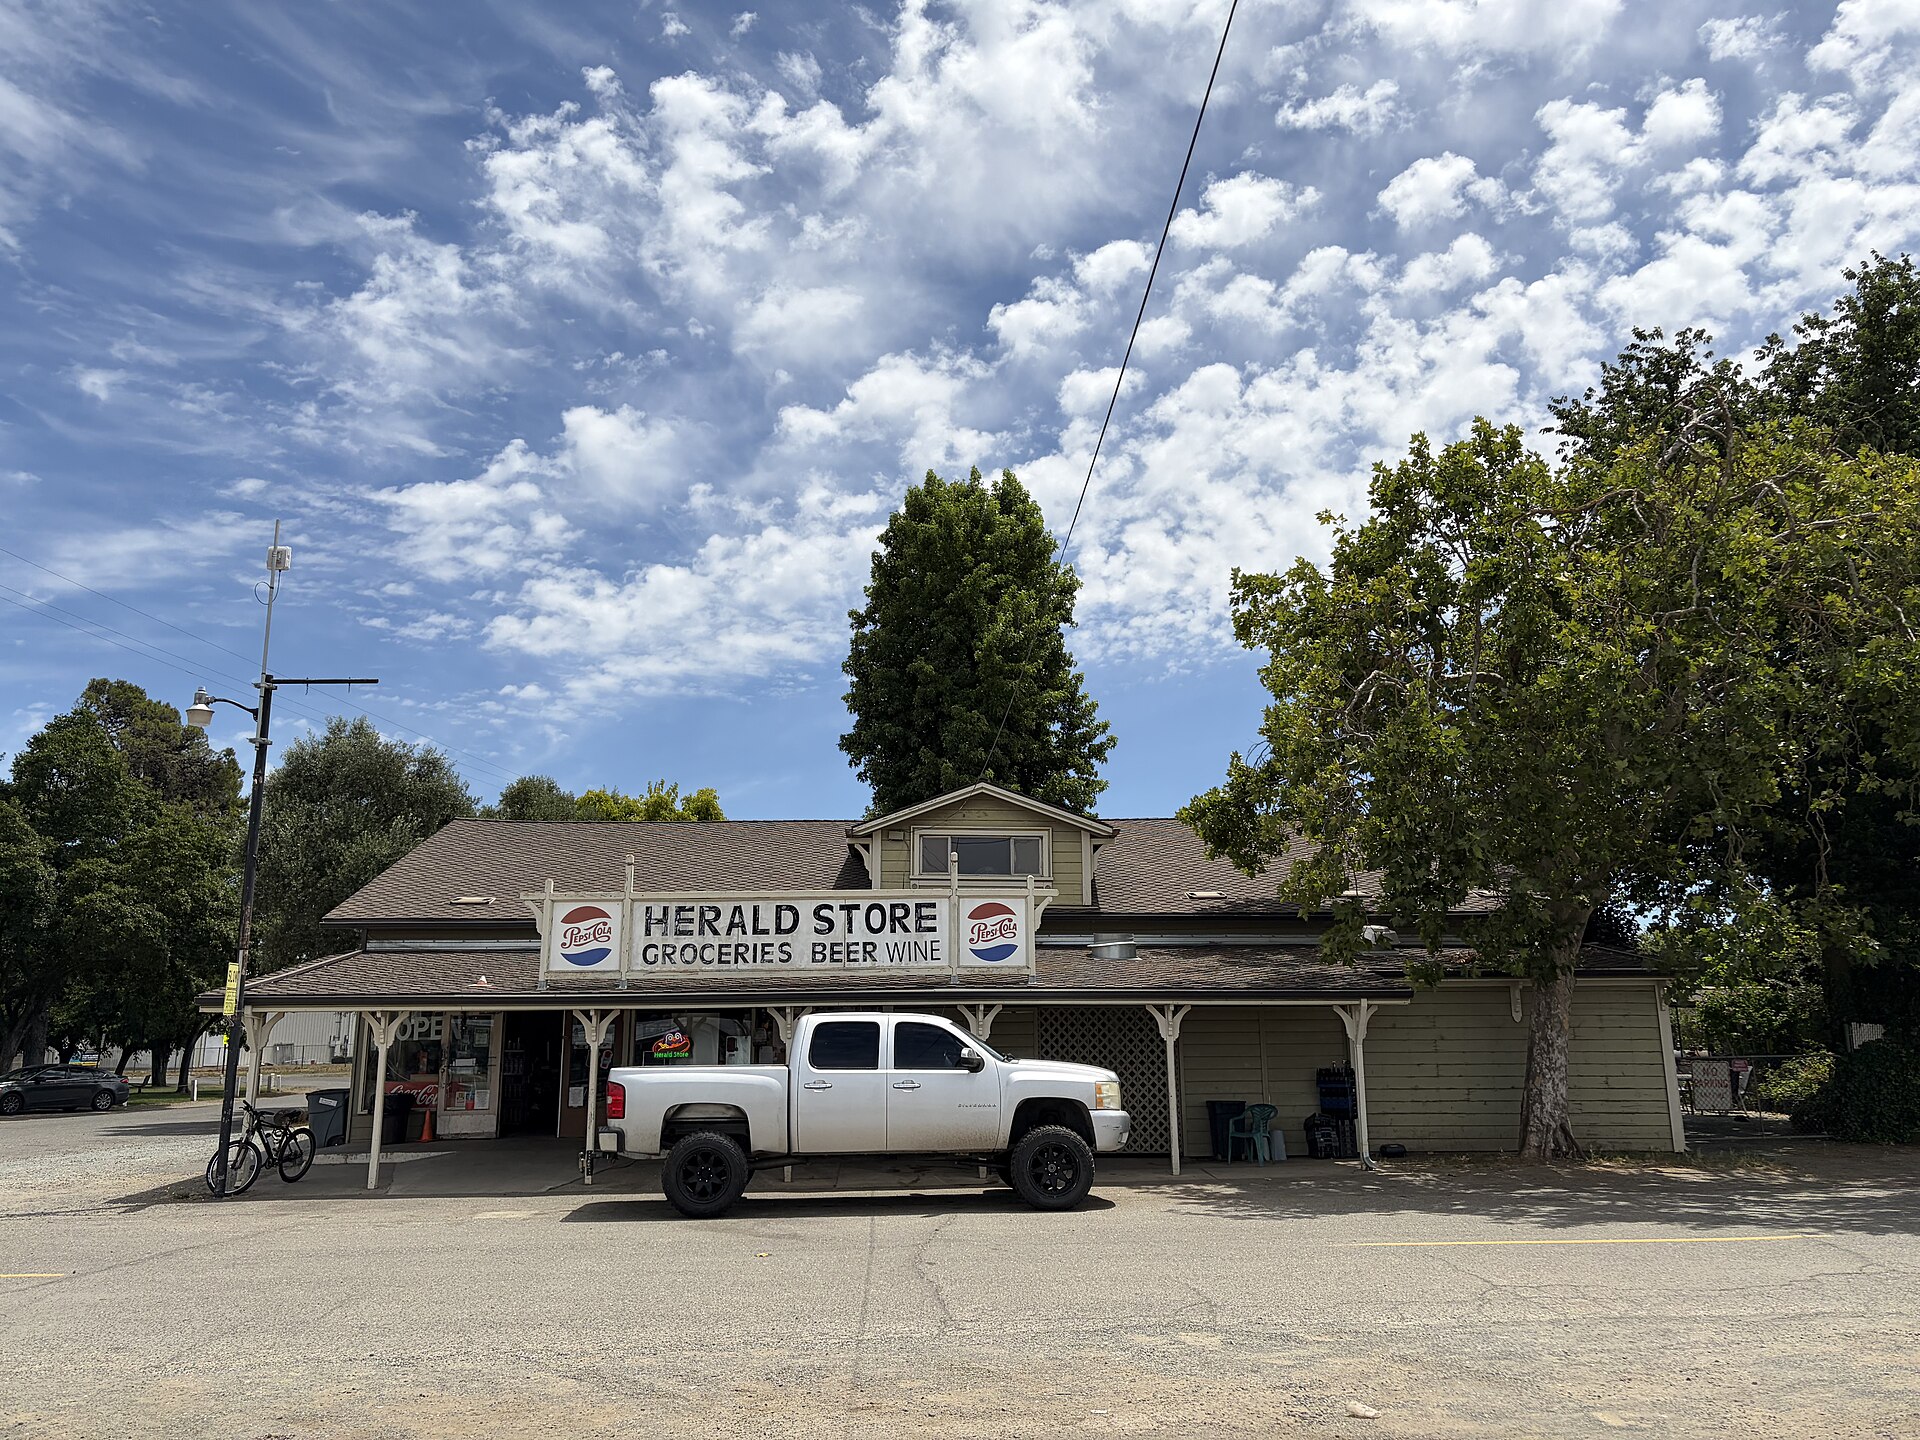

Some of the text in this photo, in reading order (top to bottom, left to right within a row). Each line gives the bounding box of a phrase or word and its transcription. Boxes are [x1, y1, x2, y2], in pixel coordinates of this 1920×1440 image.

[644, 902, 938, 937] HERALD STORE
[642, 939, 942, 965] GROCERIES BEER WINE
[1694, 1078, 1729, 1089] PARKING
